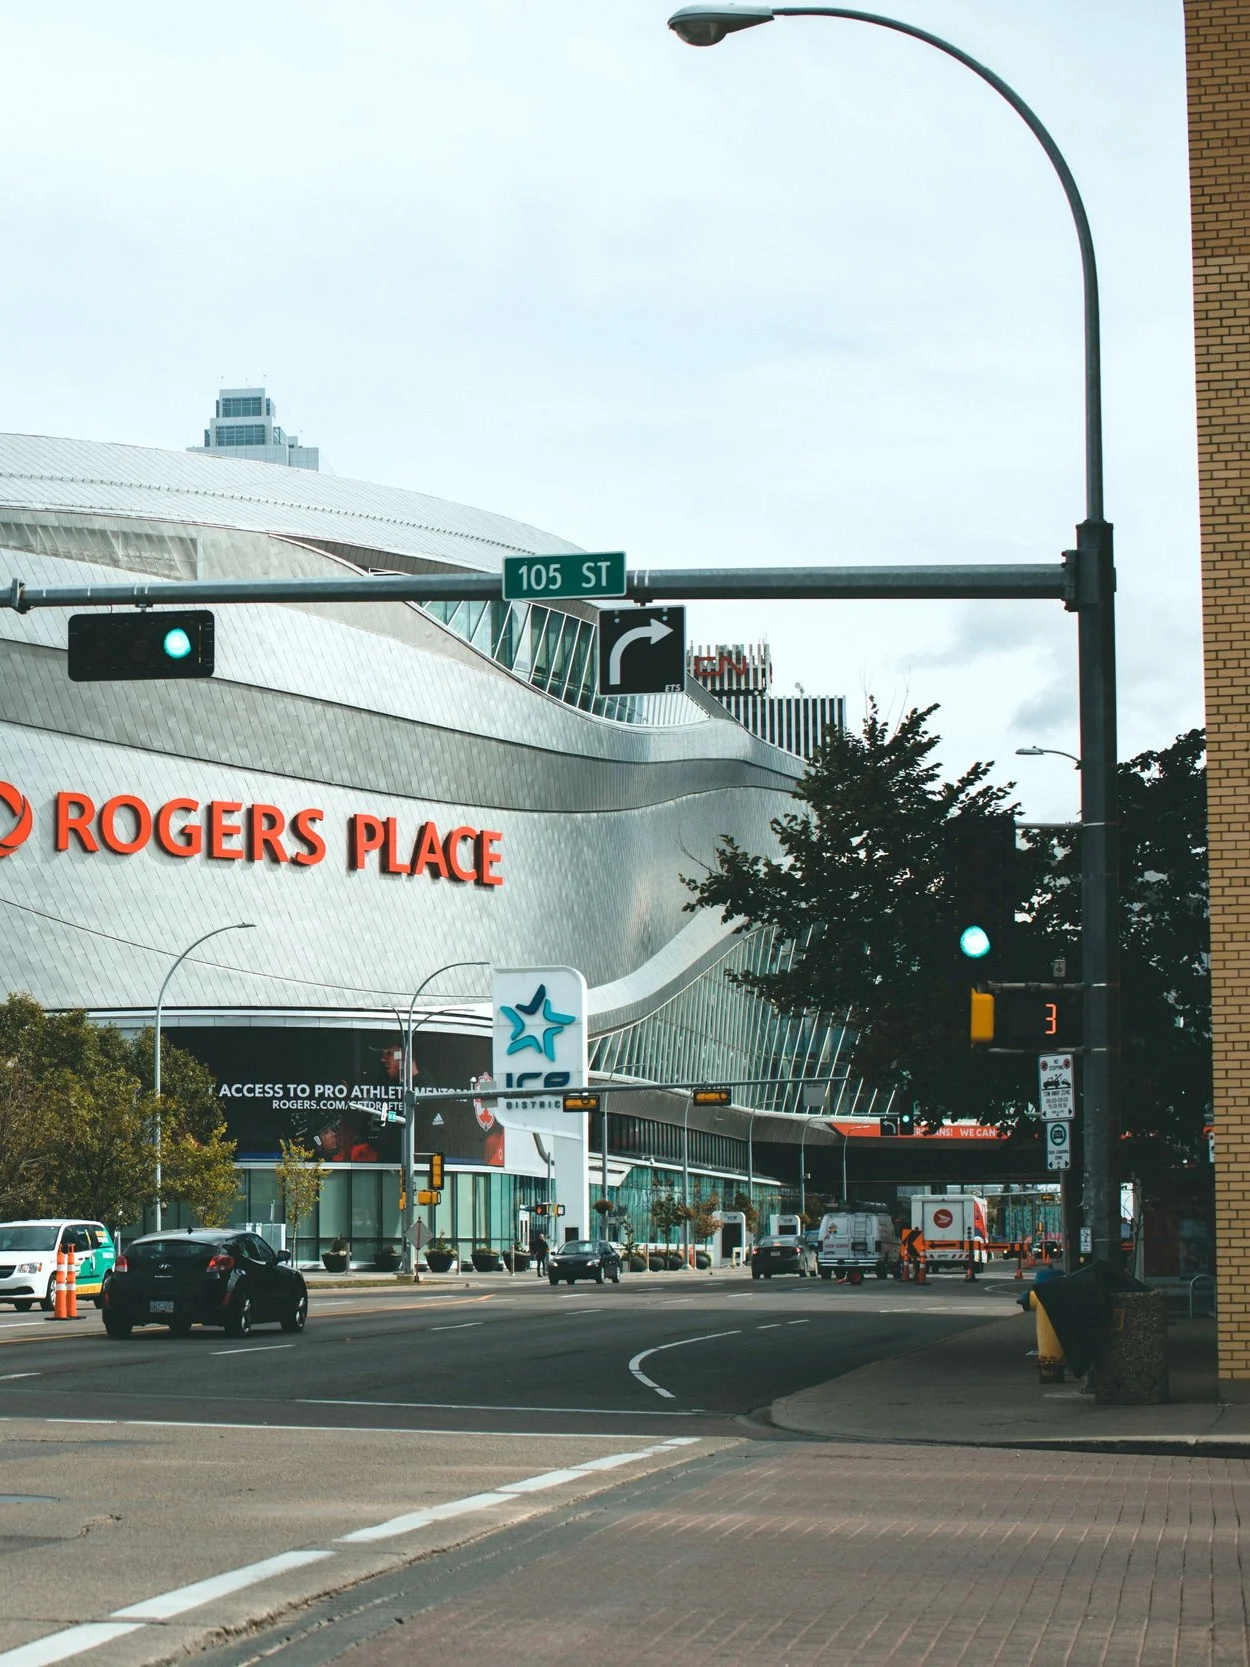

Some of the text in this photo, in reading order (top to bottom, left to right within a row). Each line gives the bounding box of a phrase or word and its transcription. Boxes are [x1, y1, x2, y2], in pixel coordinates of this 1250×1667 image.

[518, 561, 611, 591] 105 ST
[693, 655, 747, 677] CN
[665, 683, 681, 692] ETS
[54, 790, 504, 887] ROGERS PLACE
[1045, 1003, 1056, 1034] 3
[218, 1083, 284, 1098] ACCESS
[287, 1084, 310, 1098] TO
[314, 1084, 347, 1098] PRO
[350, 1085, 404, 1099] ATHLET
[506, 1100, 561, 1109] DISTRIC
[933, 1127, 953, 1137] ANS!
[959, 1127, 975, 1137] WE
